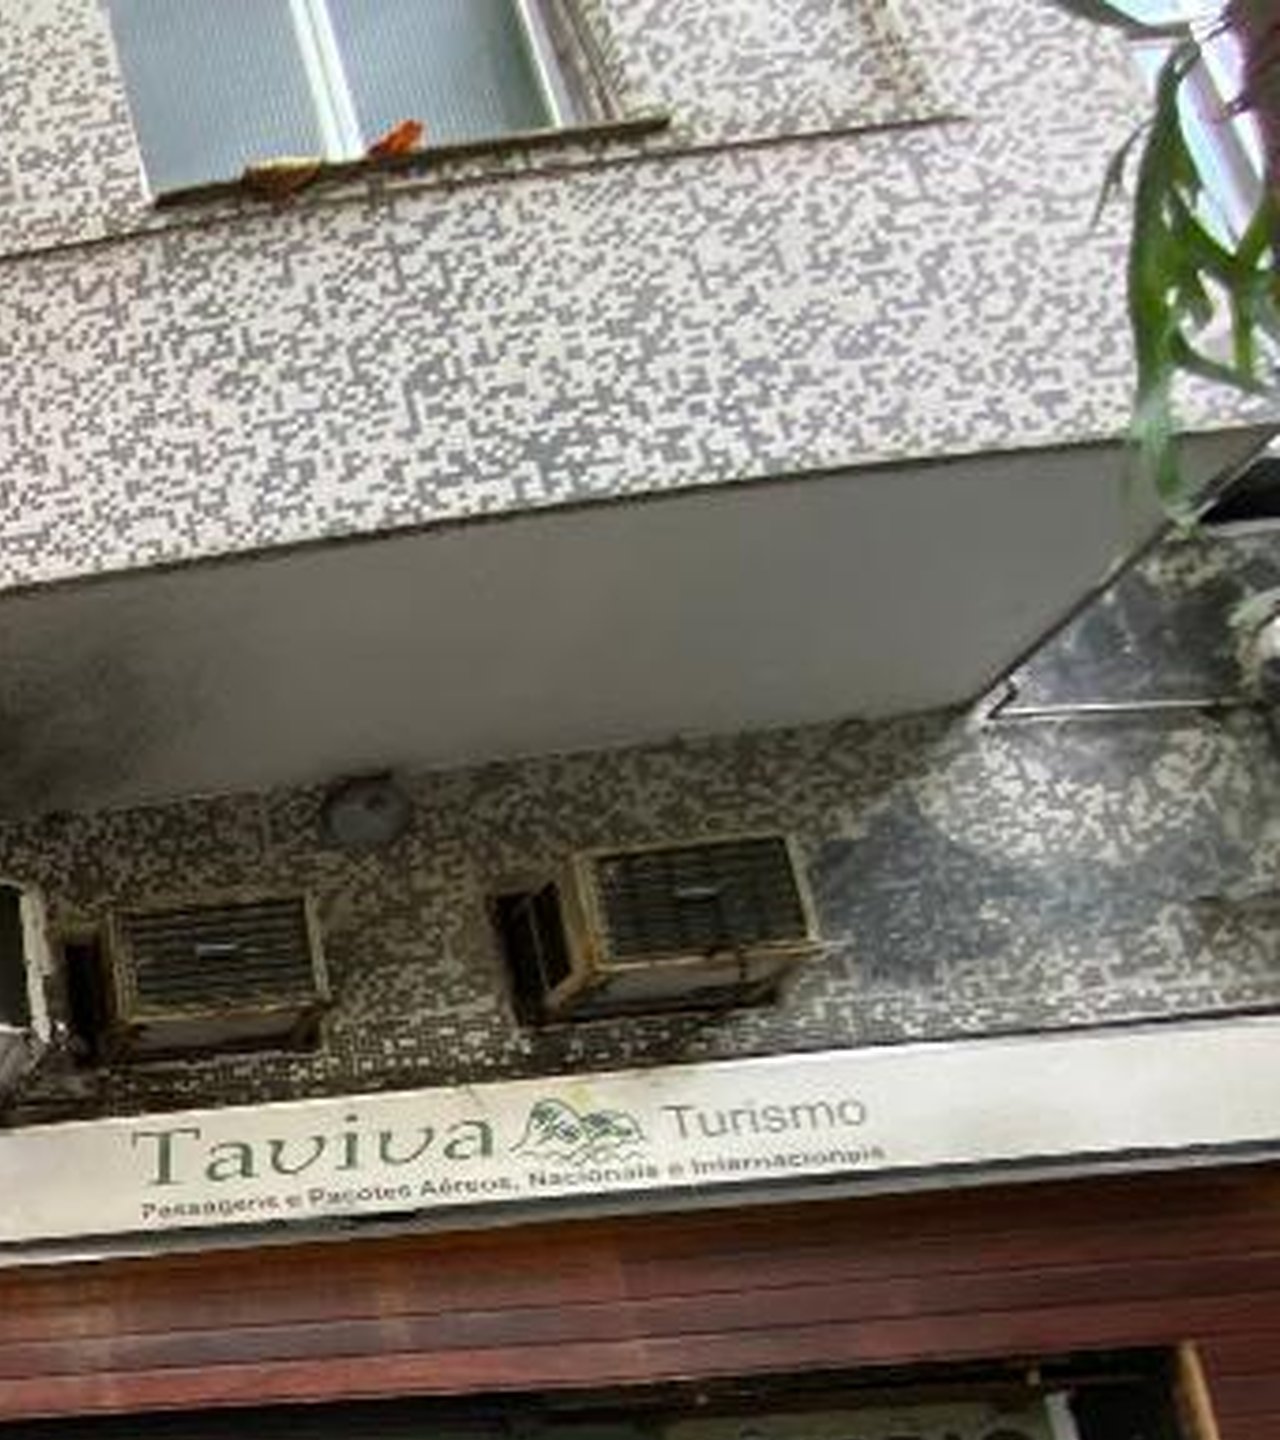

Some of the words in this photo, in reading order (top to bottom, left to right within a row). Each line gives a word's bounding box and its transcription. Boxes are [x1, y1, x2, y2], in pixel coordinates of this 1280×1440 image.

[131, 1113, 494, 1185] Taviva
[661, 1098, 867, 1139] Turismo
[528, 1163, 659, 1189] Nacionais
